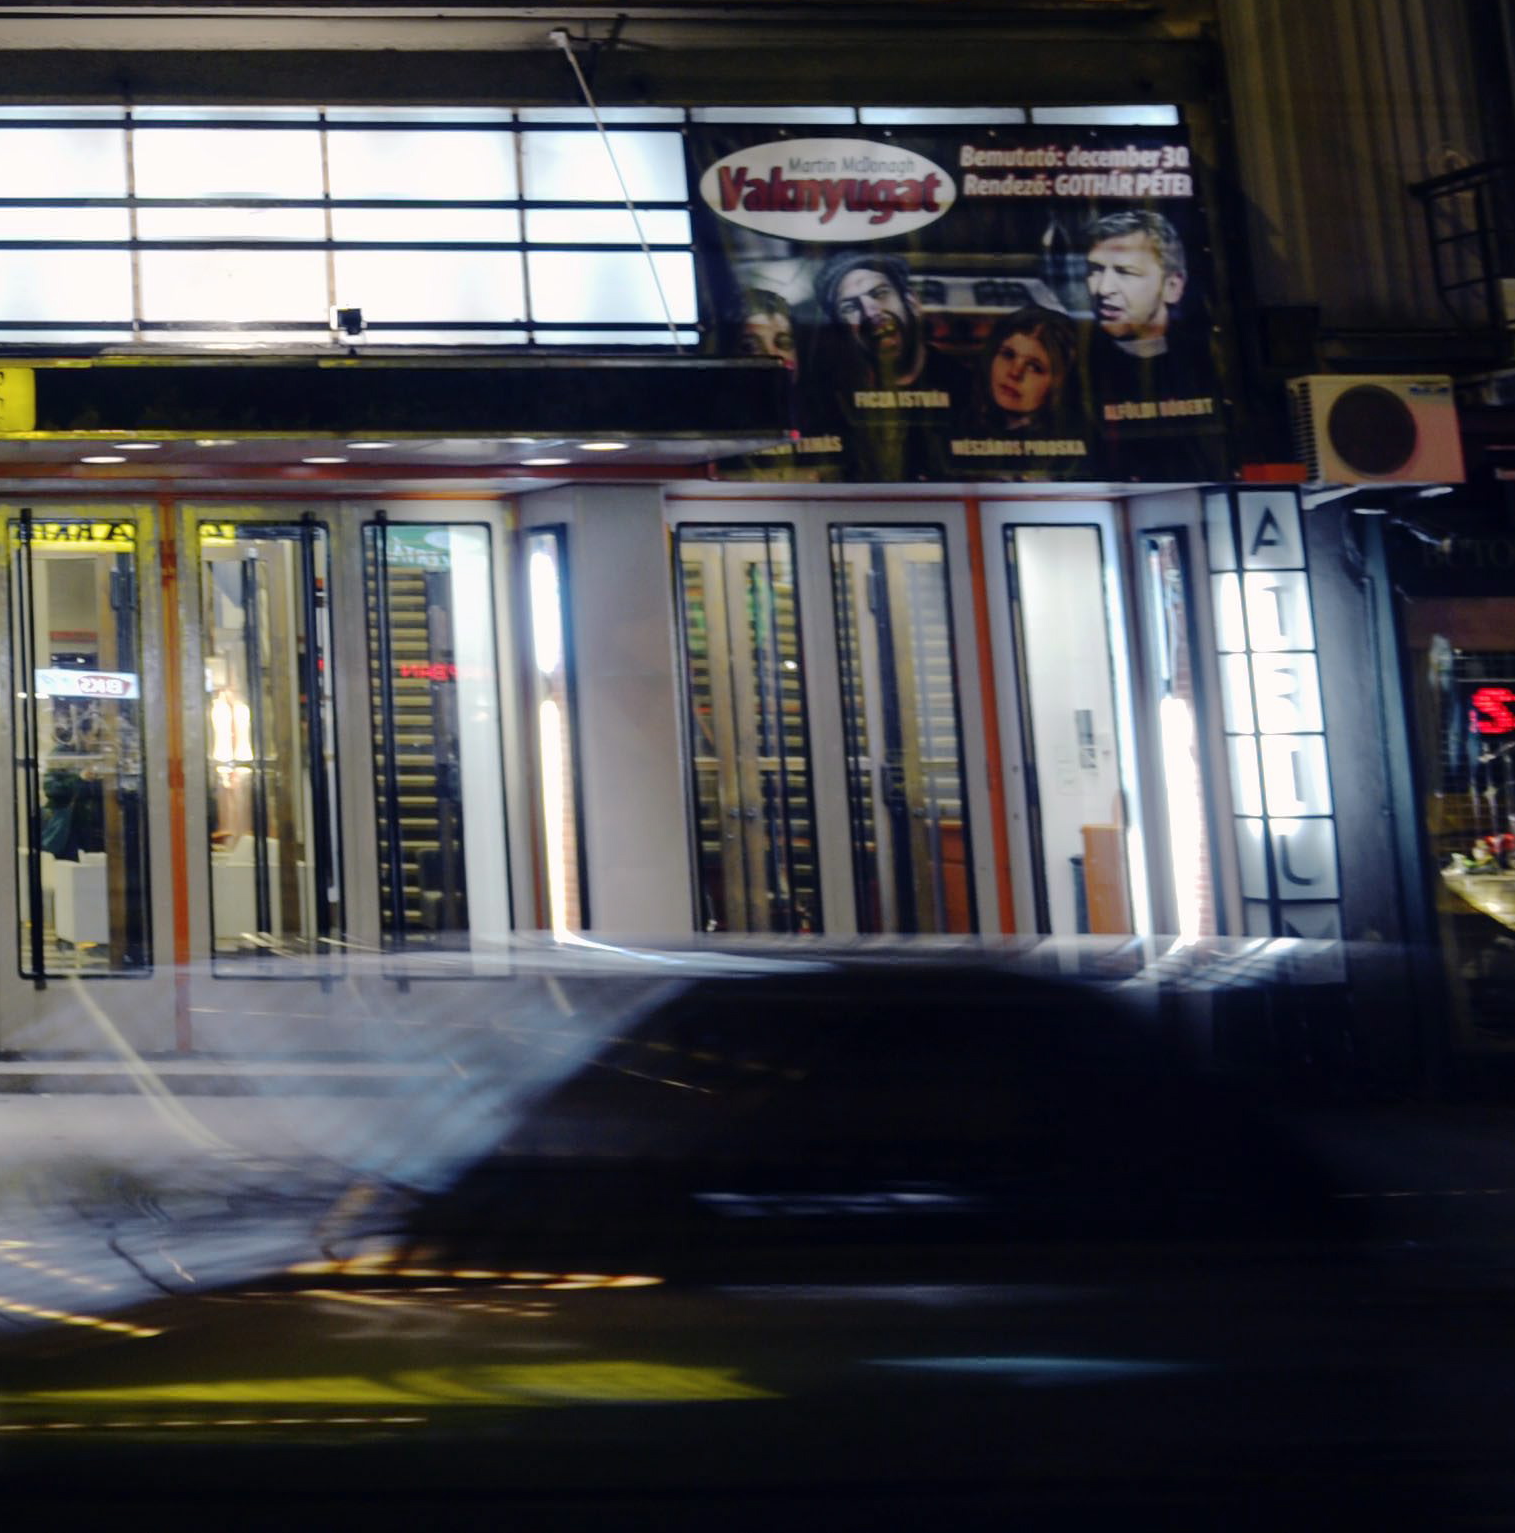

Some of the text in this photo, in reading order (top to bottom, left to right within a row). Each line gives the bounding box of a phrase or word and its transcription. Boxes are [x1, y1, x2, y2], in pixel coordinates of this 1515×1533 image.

[788, 156, 915, 177] Martin McDonagh
[960, 145, 1189, 167] Bemutató: december 30
[1054, 170, 1134, 196] GOTHÁR
[1135, 170, 1193, 196] PÉTER
[718, 166, 942, 225] Vaknyugat
